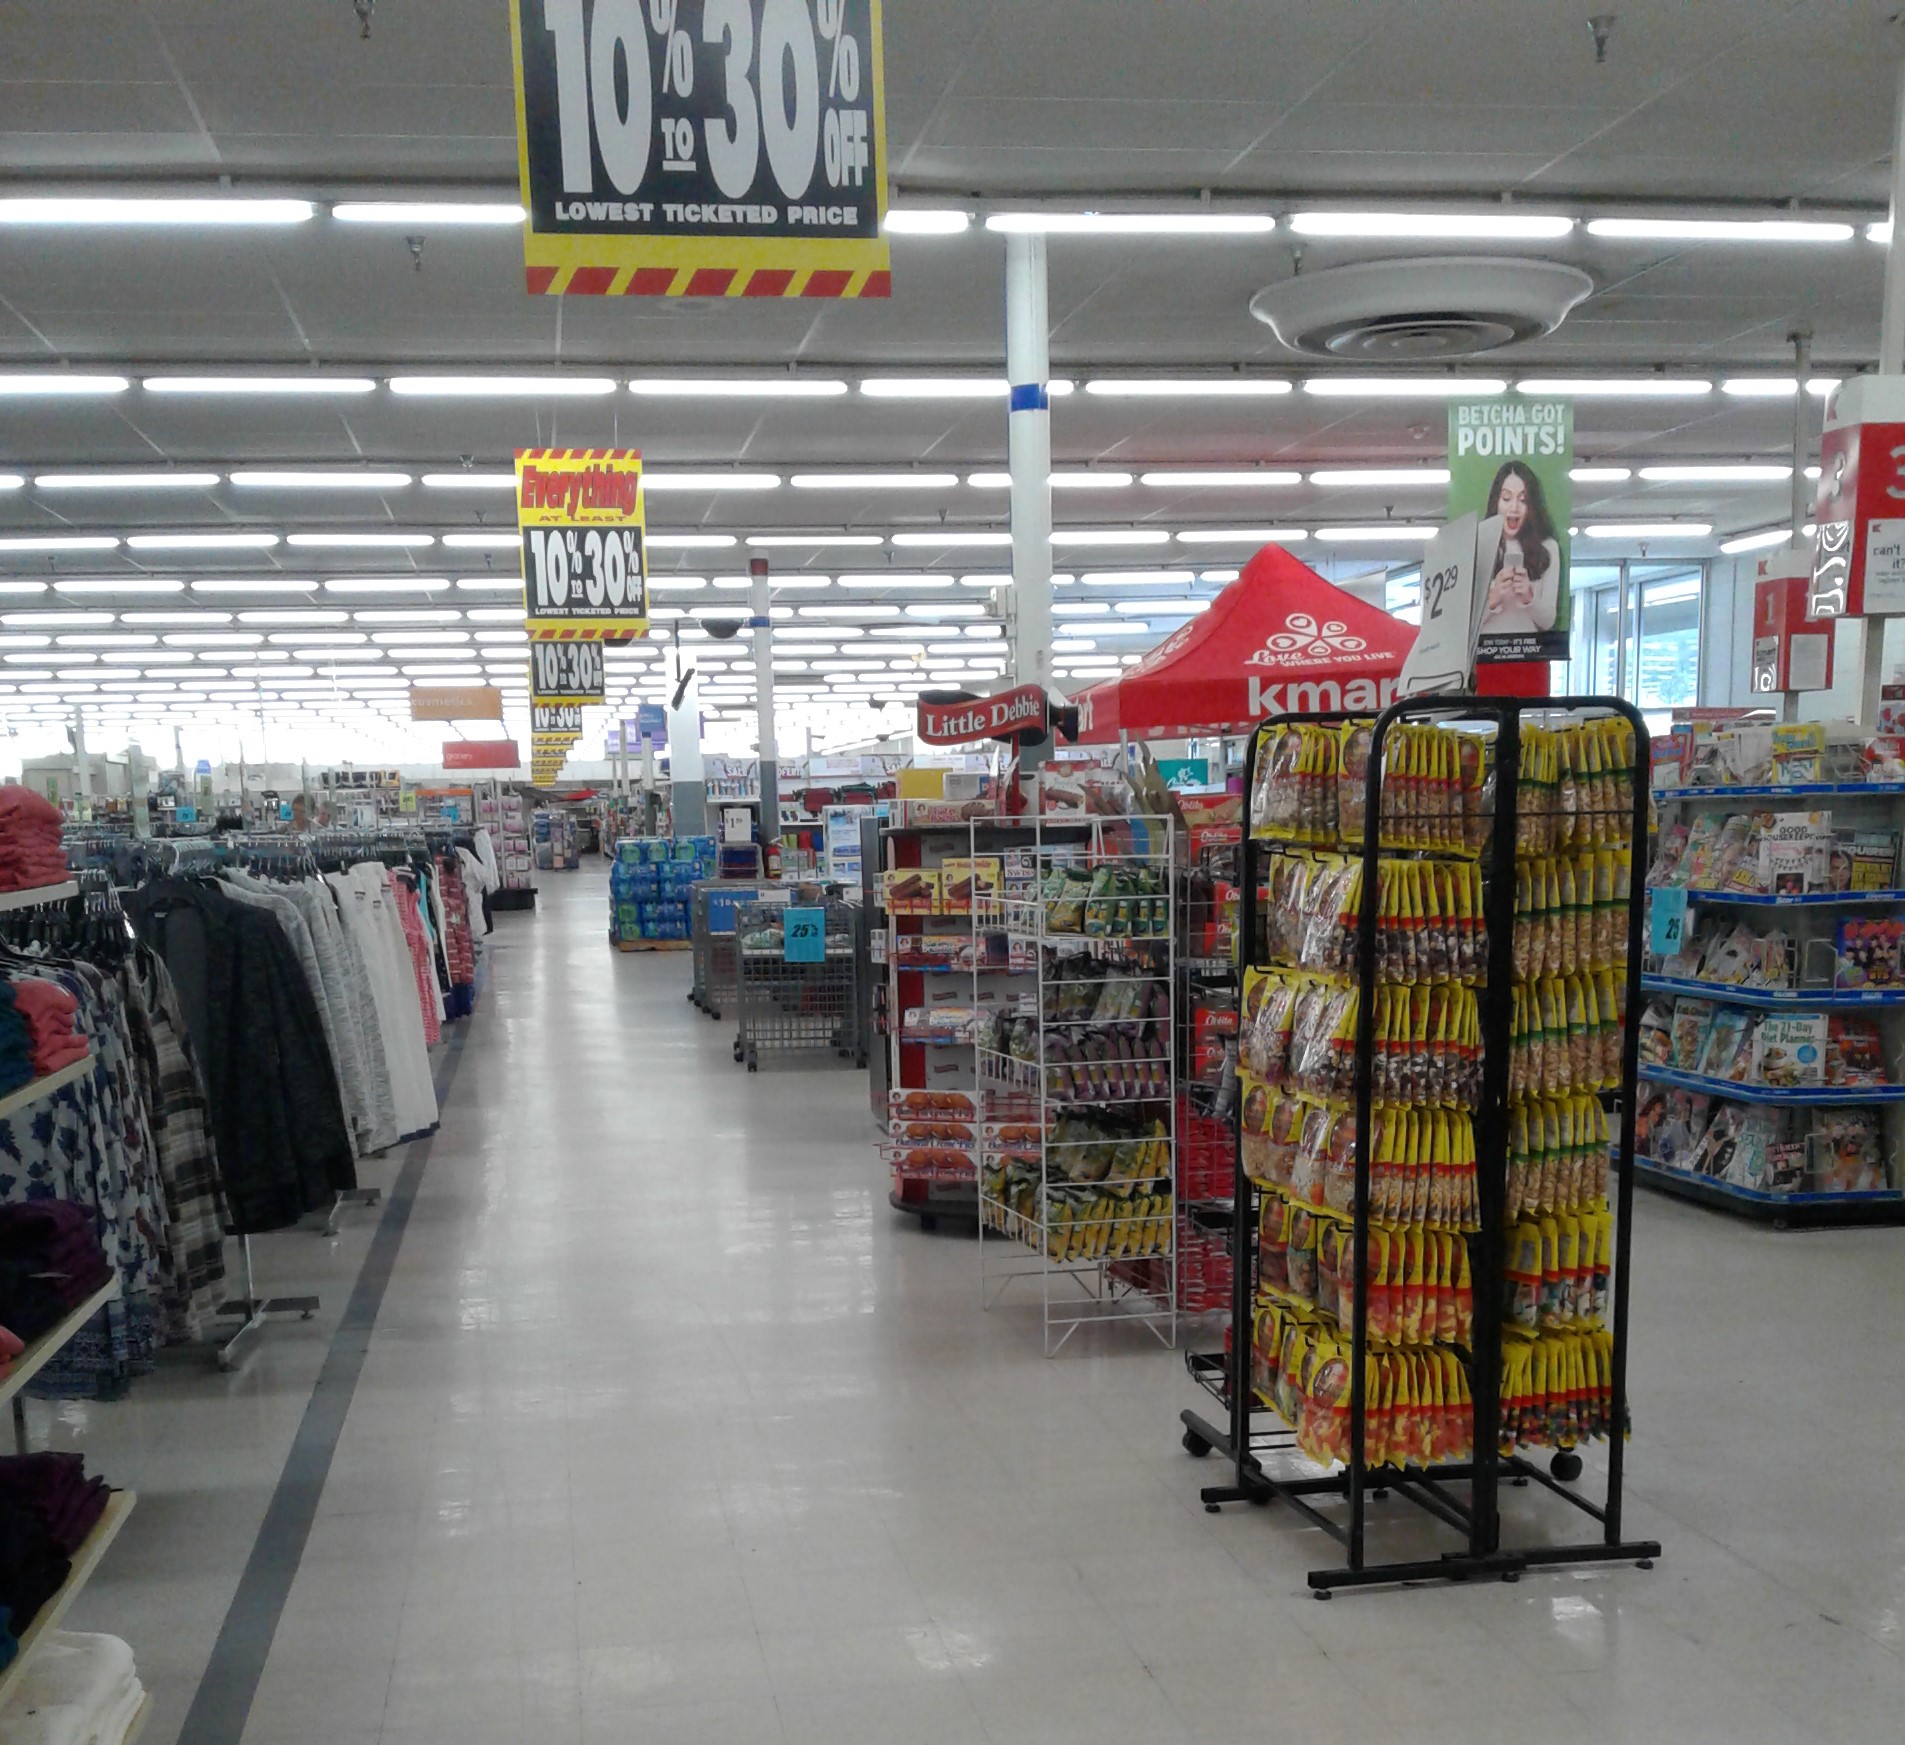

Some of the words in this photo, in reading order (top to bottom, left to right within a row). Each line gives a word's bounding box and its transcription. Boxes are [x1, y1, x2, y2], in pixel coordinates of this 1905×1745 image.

[661, 118, 696, 171] TO
[823, 107, 868, 188] OFF
[555, 202, 654, 222] LOWEST
[662, 203, 778, 224] TICKETED
[787, 206, 858, 225] PRICE
[1458, 404, 1526, 425] BETCHA
[1531, 403, 1565, 424] GOT
[1457, 424, 1565, 456] POINTS!
[521, 464, 639, 516] Everything
[1872, 544, 1901, 556] can't
[626, 576, 643, 602] OFF
[1244, 650, 1304, 666] Love
[1279, 657, 1333, 667] WHERE
[1334, 655, 1362, 663] YOU
[1364, 651, 1396, 661] LIVE
[1499, 645, 1522, 654] YOUR
[1522, 645, 1542, 653] WAY
[926, 711, 985, 737] Little
[991, 694, 1040, 727] Debbie
